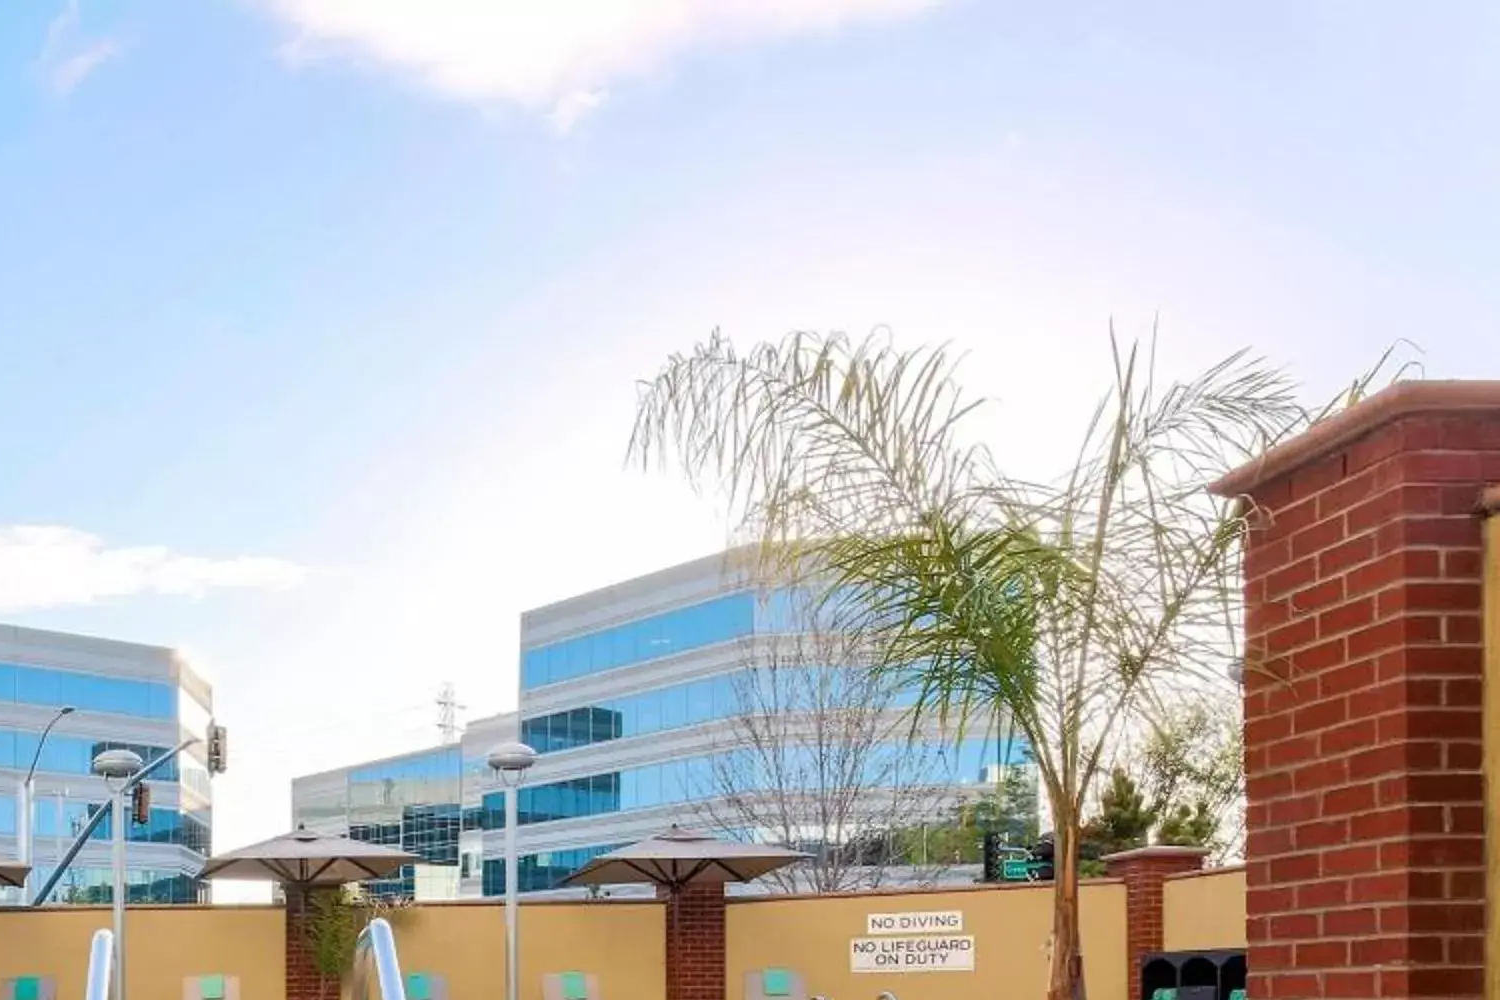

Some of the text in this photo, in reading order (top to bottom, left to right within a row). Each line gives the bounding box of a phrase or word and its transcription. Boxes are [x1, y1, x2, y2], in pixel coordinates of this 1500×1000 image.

[871, 915, 959, 929] NO DIVING
[853, 939, 971, 953] NO LIFEGUARD
[875, 953, 949, 965] ON DUTY
